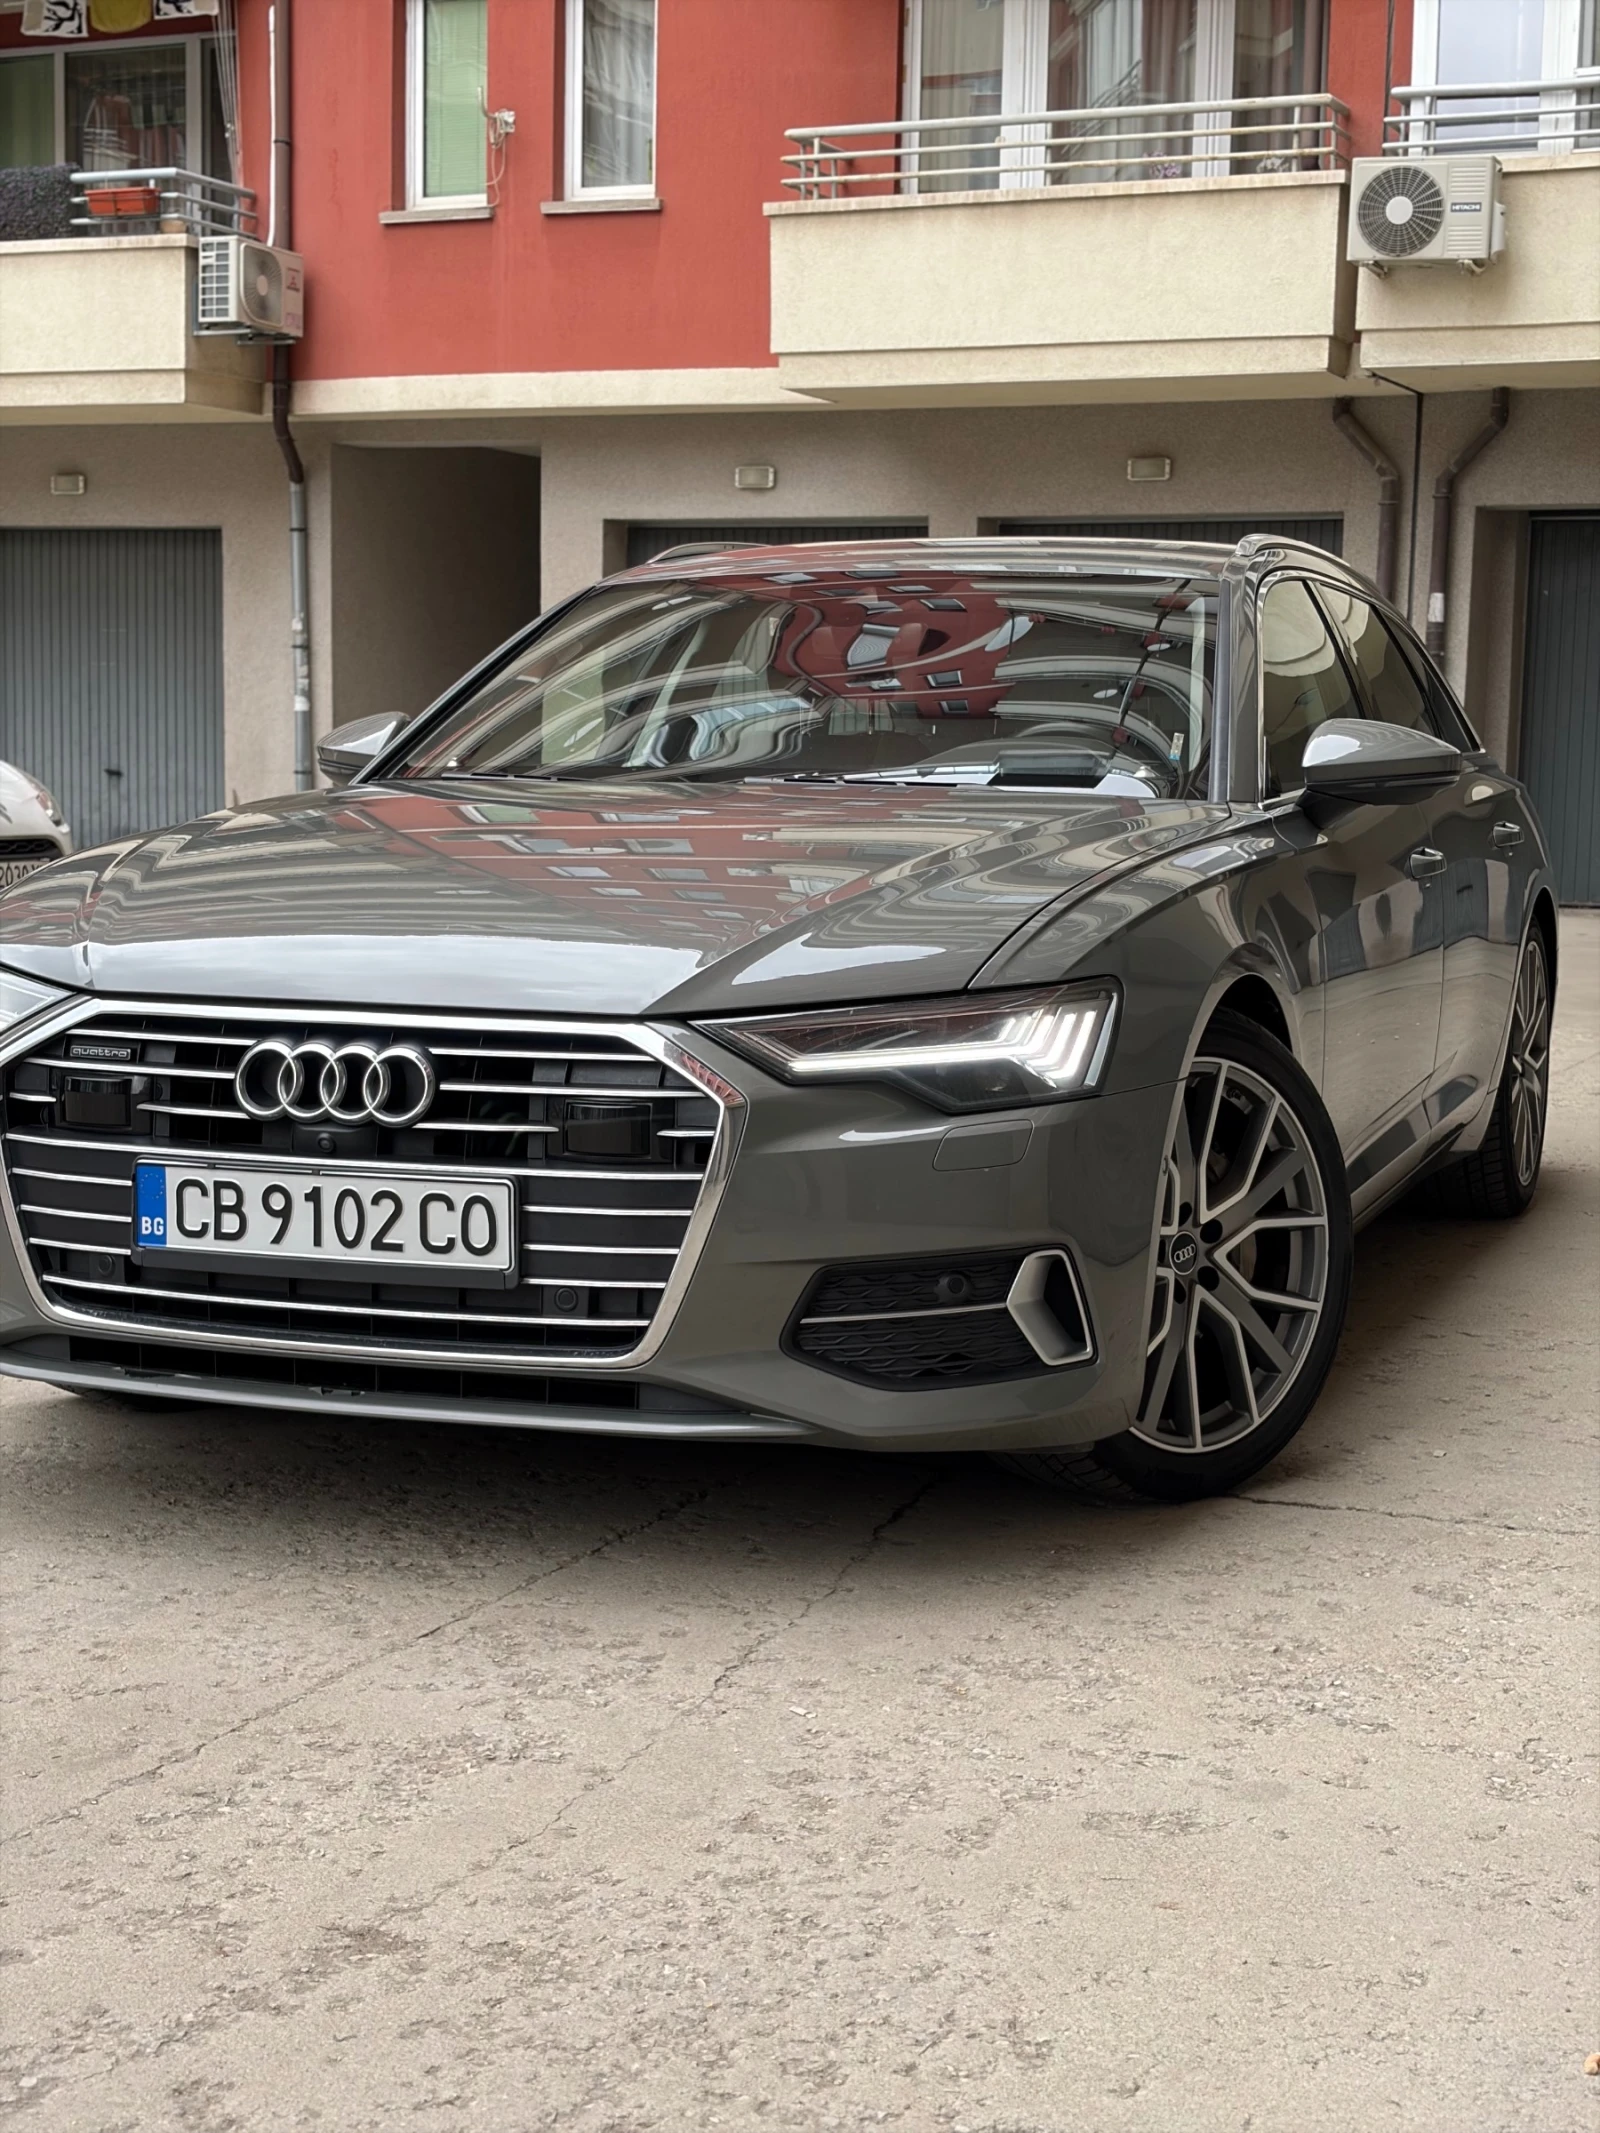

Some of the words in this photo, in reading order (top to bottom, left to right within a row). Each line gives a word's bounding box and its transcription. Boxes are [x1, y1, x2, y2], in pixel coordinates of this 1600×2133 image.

[72, 1047, 127, 1058] quattro
[141, 1216, 165, 1236] BG
[176, 1178, 248, 1241] CB
[261, 1183, 404, 1253] 9102
[419, 1192, 497, 1257] CO
